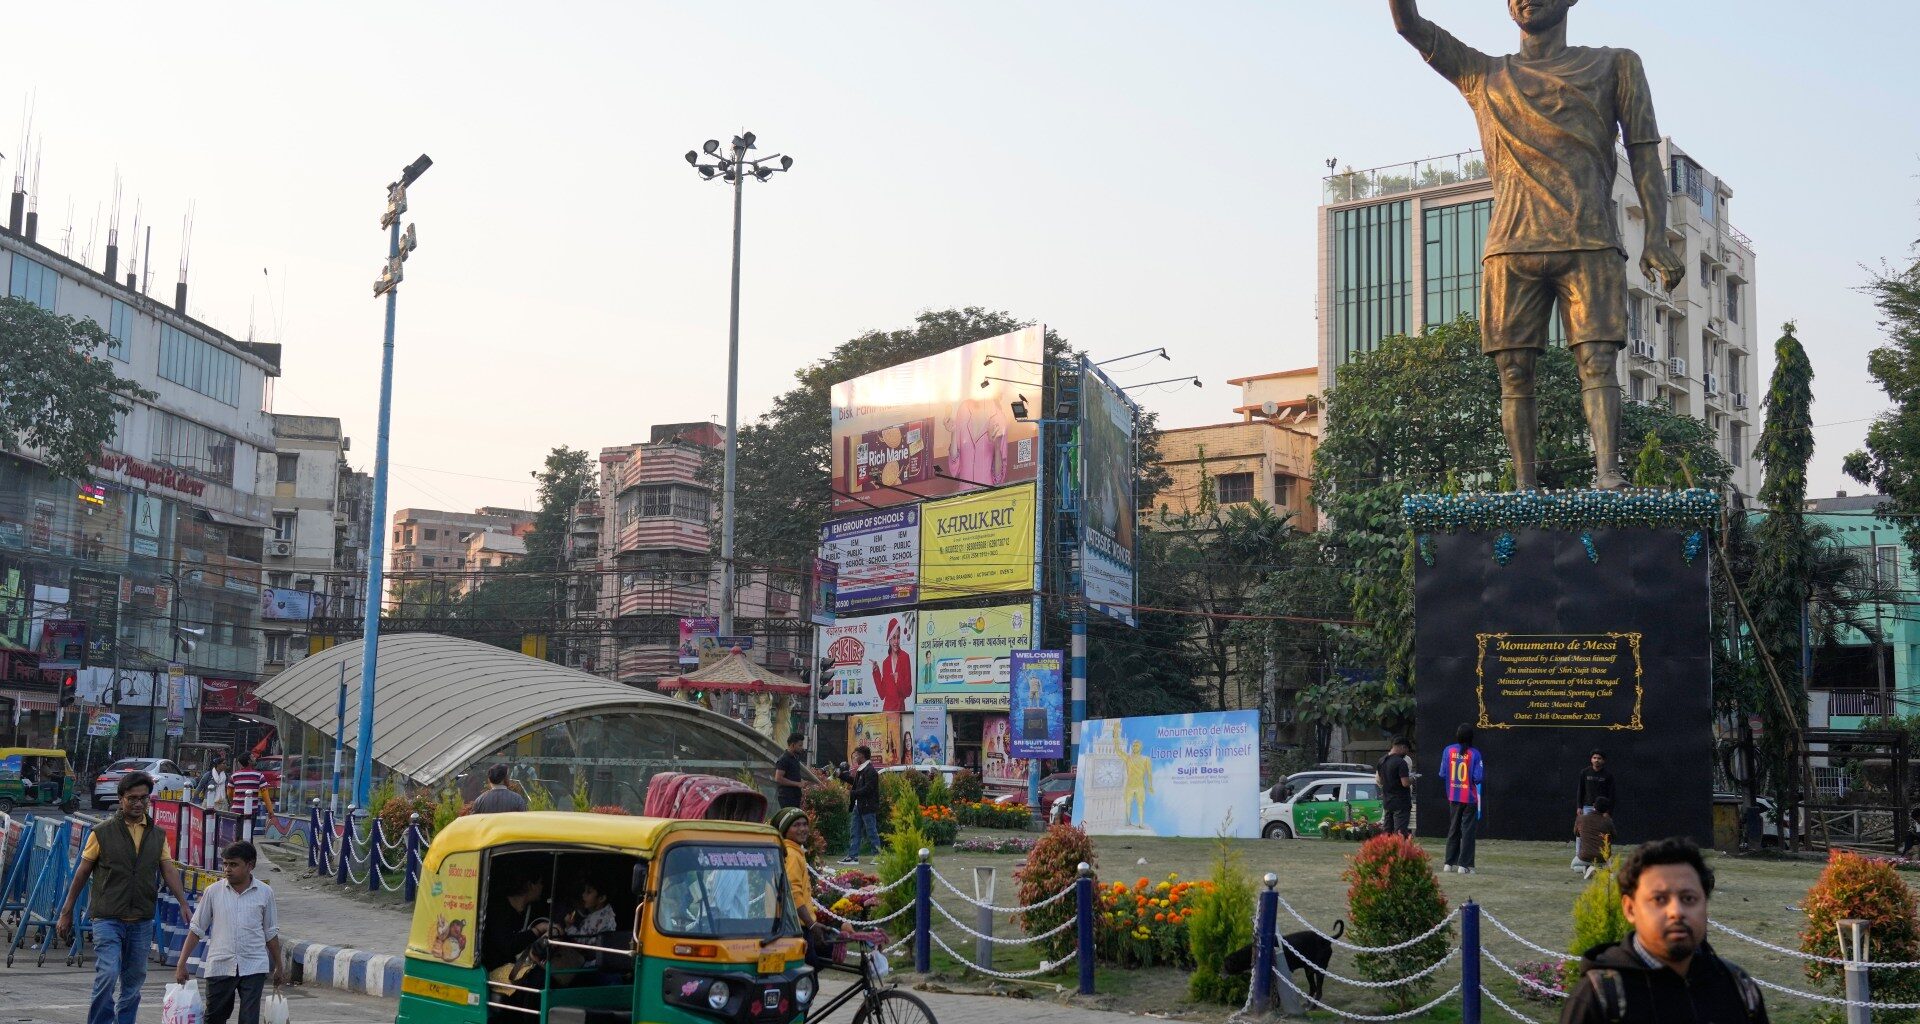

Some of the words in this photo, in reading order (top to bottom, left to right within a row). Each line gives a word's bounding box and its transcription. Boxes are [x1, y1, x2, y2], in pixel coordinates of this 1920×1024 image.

[869, 450, 886, 466] Rich
[886, 445, 909, 462] Marie
[859, 466, 866, 478] 25
[832, 524, 842, 534] IEM
[842, 520, 864, 532] GROUP
[864, 518, 872, 528] OF
[873, 512, 904, 525] SCHOOLS
[936, 508, 1014, 536] KARUKRIT
[874, 534, 882, 542] IEM
[870, 544, 886, 554] PUBLIC
[894, 540, 912, 550] PUBLIC
[847, 548, 862, 558] PUBLIC
[892, 551, 912, 560] SCHOOL
[846, 559, 864, 568] SCHOOL
[868, 555, 888, 564] SCHOOL
[1496, 640, 1565, 650] Monumento
[1566, 639, 1580, 650] de
[1583, 640, 1618, 650] Messi
[1539, 655, 1548, 663] by
[1592, 655, 1617, 663] himself
[1548, 667, 1557, 675] of
[1573, 666, 1589, 675] Sujit
[1566, 690, 1595, 698] Sporting
[1156, 726, 1207, 737] Monumento
[1210, 726, 1220, 734] de
[1224, 723, 1247, 734] Messi
[1151, 747, 1181, 759] Lionel
[1185, 746, 1212, 757] Messi
[1216, 744, 1252, 756] himself
[1177, 767, 1198, 775] Sujit
[1451, 761, 1467, 782] 10
